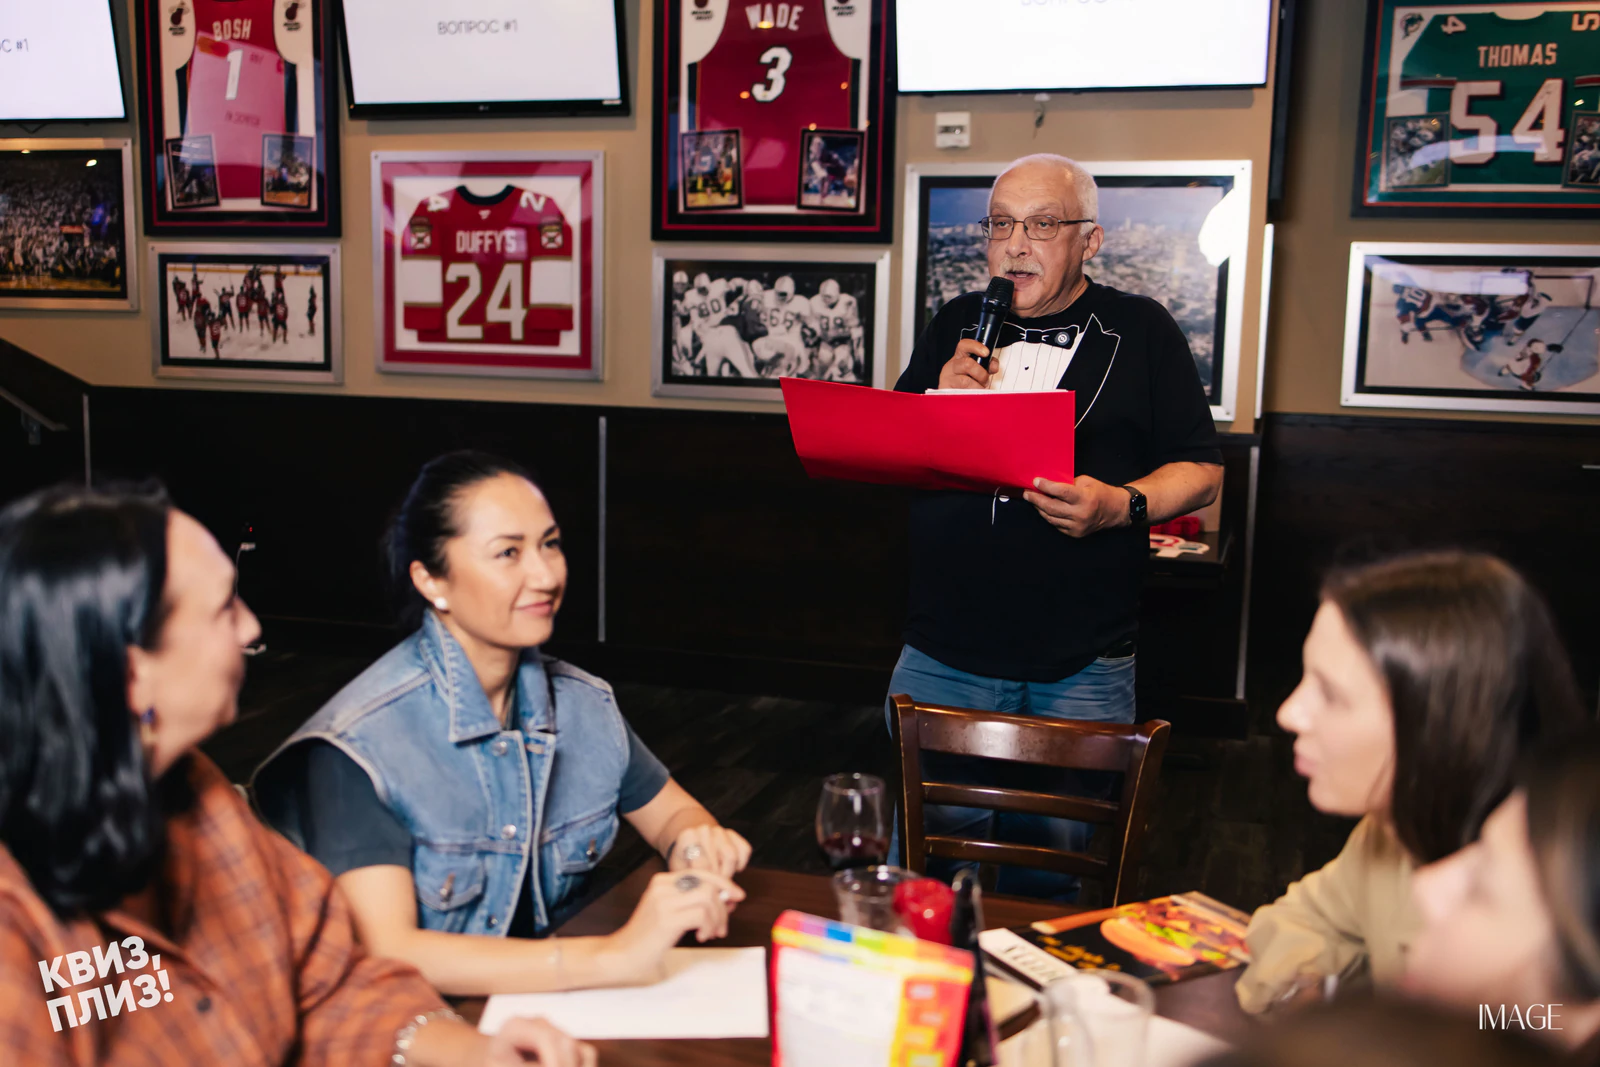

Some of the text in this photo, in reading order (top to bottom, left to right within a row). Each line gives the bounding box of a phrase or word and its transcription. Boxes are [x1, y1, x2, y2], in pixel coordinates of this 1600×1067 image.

[212, 18, 252, 42] BOSH
[437, 20, 500, 36] ВОПРОС
[745, 3, 803, 31] WADE
[225, 48, 244, 101] 1
[751, 46, 793, 102] 3
[1477, 42, 1558, 69] THOMAS
[1449, 77, 1566, 166] 54
[445, 261, 529, 341] 24
